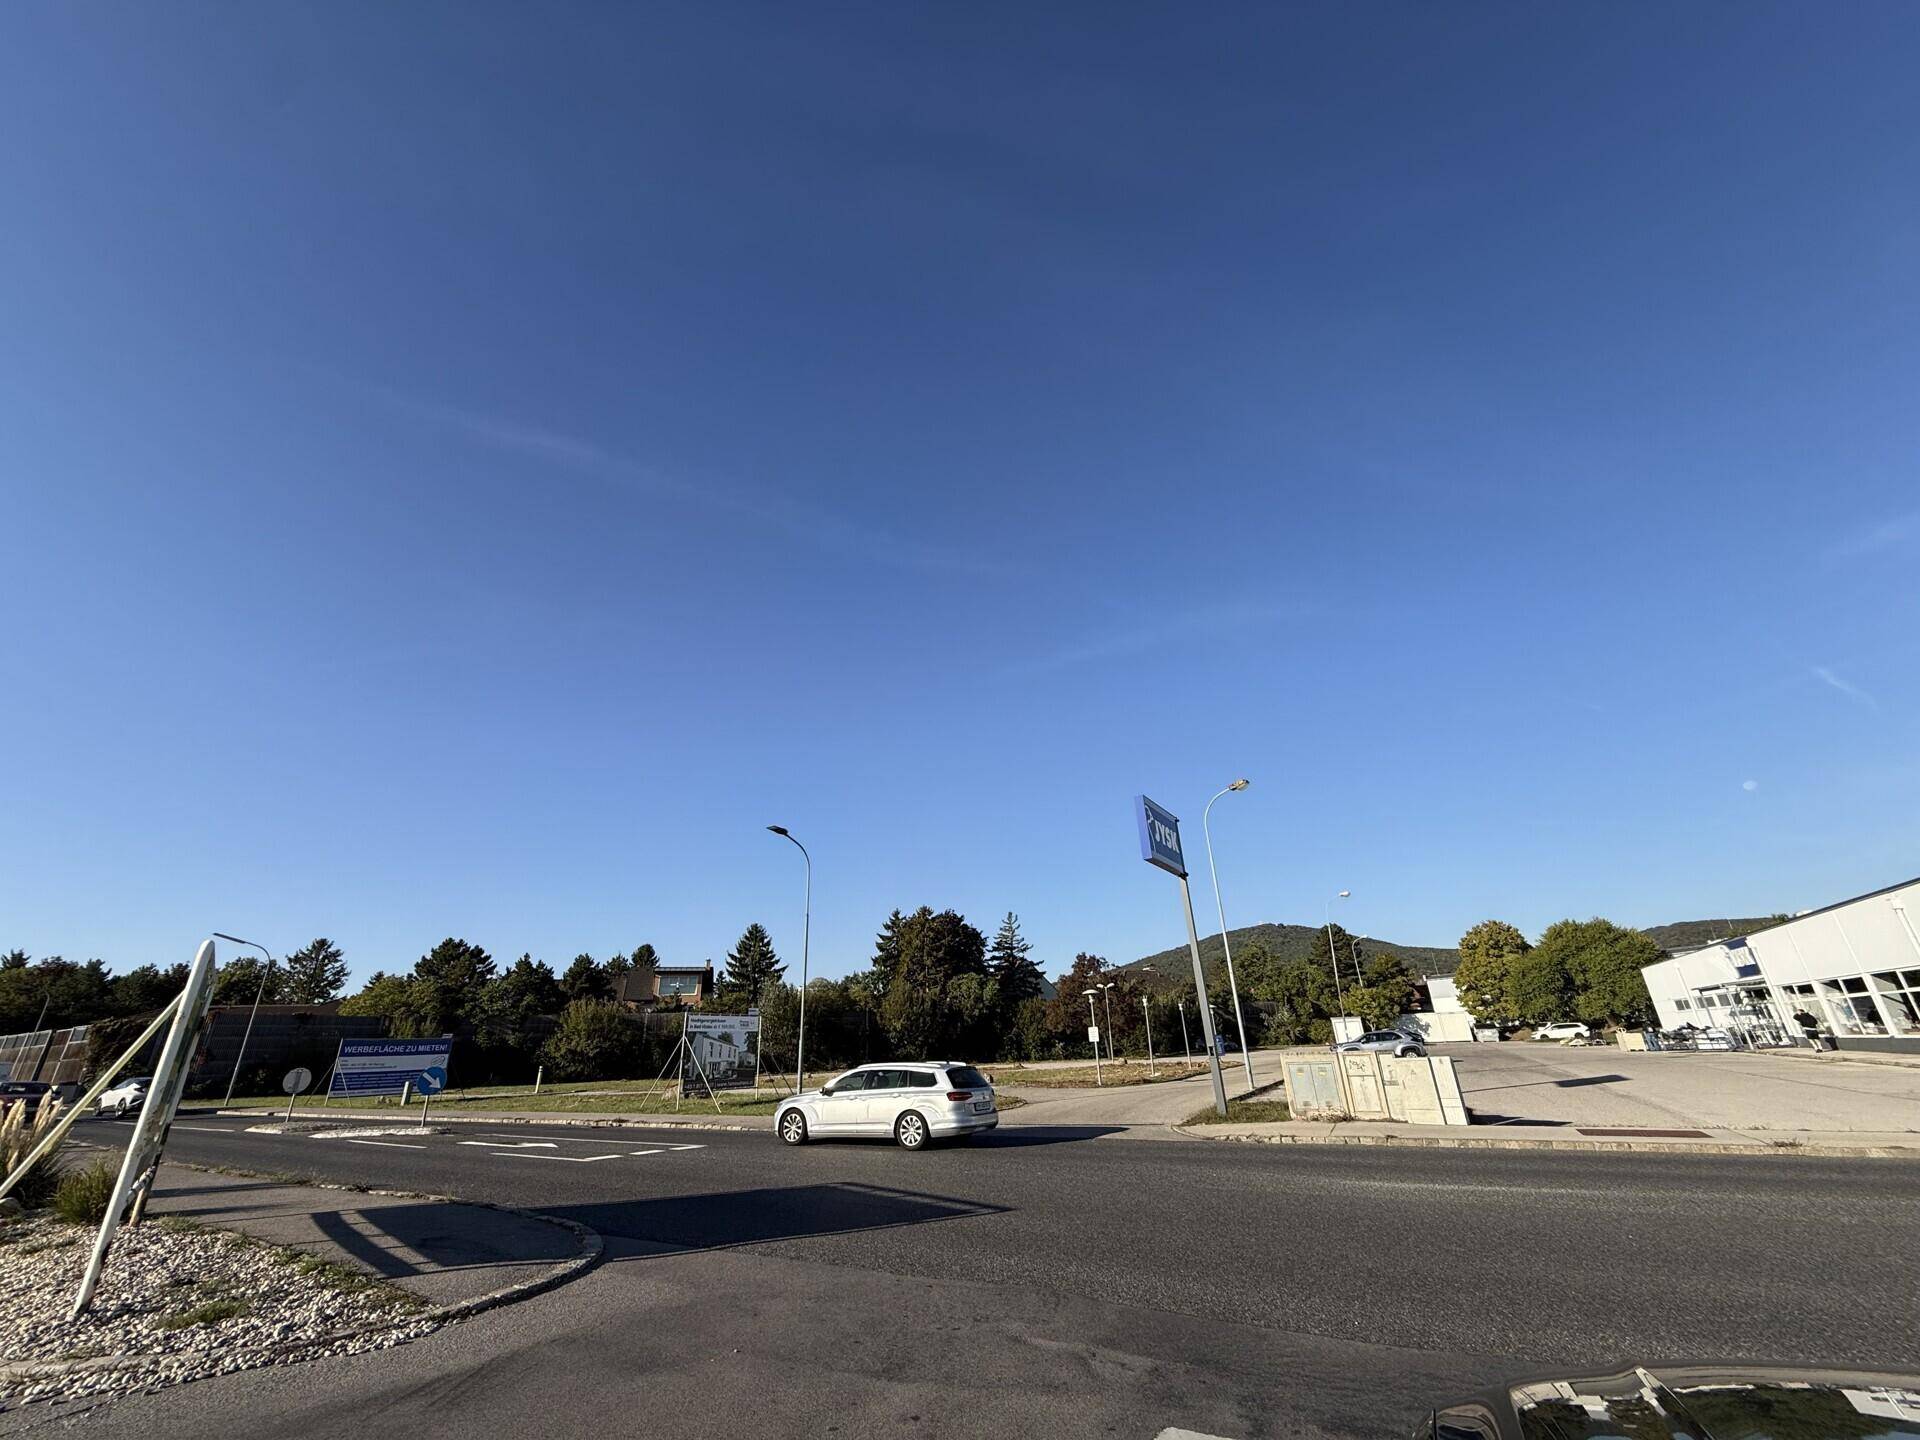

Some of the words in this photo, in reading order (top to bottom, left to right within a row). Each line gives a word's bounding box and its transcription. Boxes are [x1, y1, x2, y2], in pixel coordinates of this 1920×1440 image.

[1155, 819, 1180, 853] JYSK
[344, 1044, 404, 1053] WERBEFLÄCHE
[418, 1044, 448, 1052] MIETEN!
